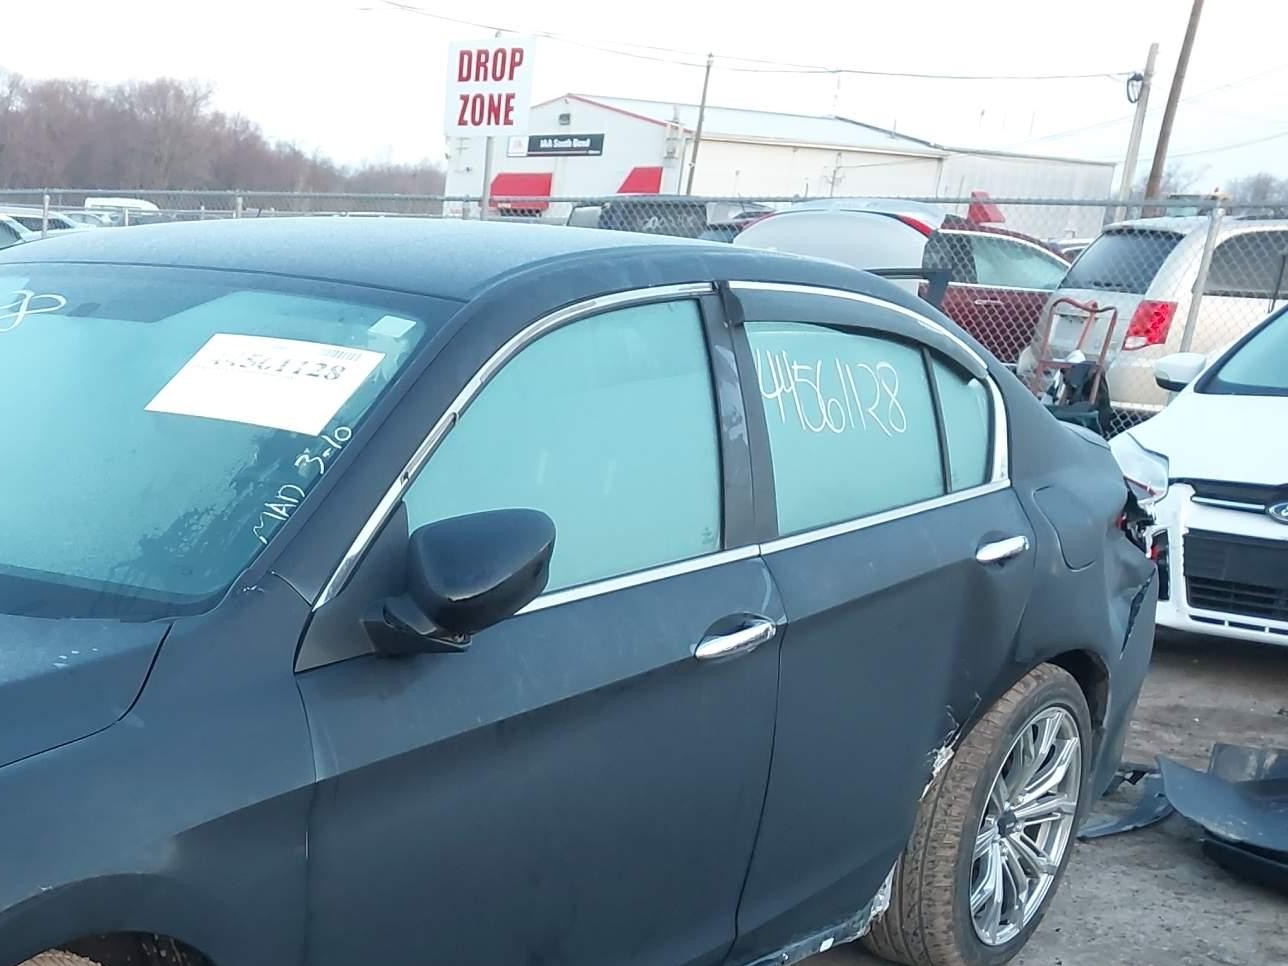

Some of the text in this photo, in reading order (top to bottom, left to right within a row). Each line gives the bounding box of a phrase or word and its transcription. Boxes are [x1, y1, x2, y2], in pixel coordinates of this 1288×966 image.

[457, 47, 524, 82] DROP
[457, 92, 516, 126] ZONE
[756, 348, 907, 437] 44561128
